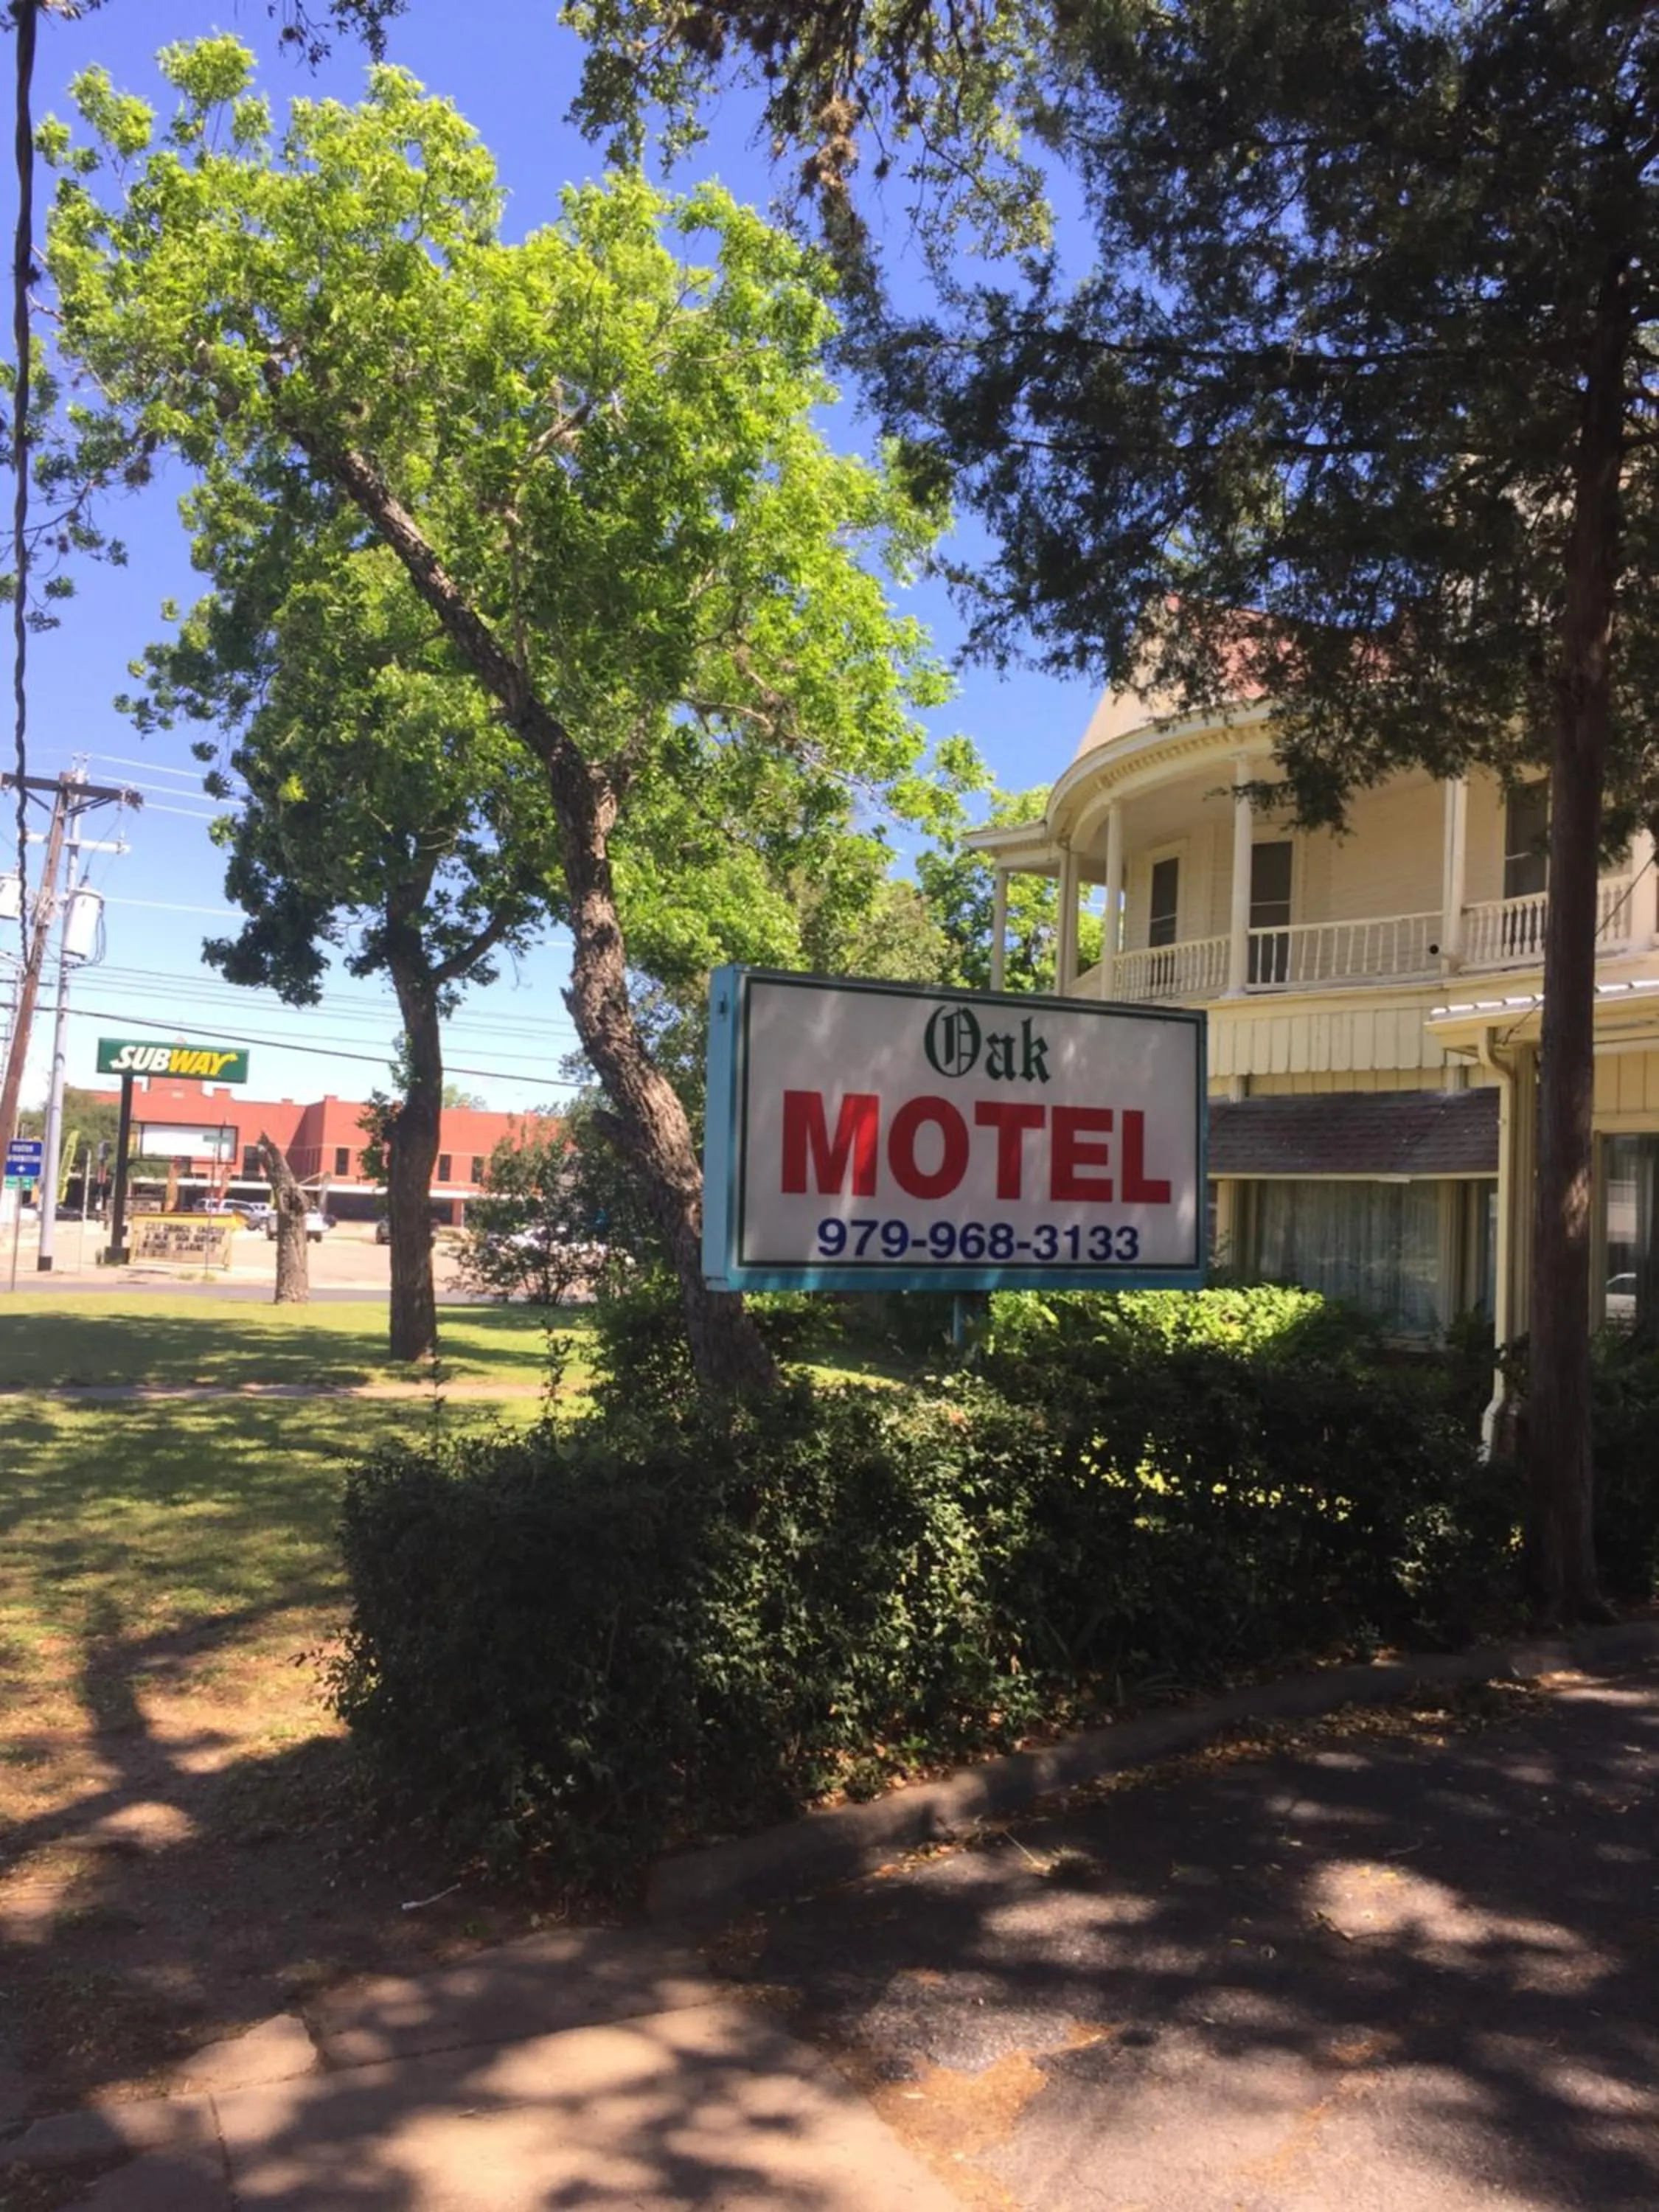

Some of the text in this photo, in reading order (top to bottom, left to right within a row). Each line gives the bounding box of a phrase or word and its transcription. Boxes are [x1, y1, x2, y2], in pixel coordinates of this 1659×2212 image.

[110, 1046, 237, 1076] SUBWAY
[924, 1005, 1051, 1084] Oak
[781, 1089, 1172, 1203] MOTEL
[817, 1217, 1140, 1262] 979-968-3133
